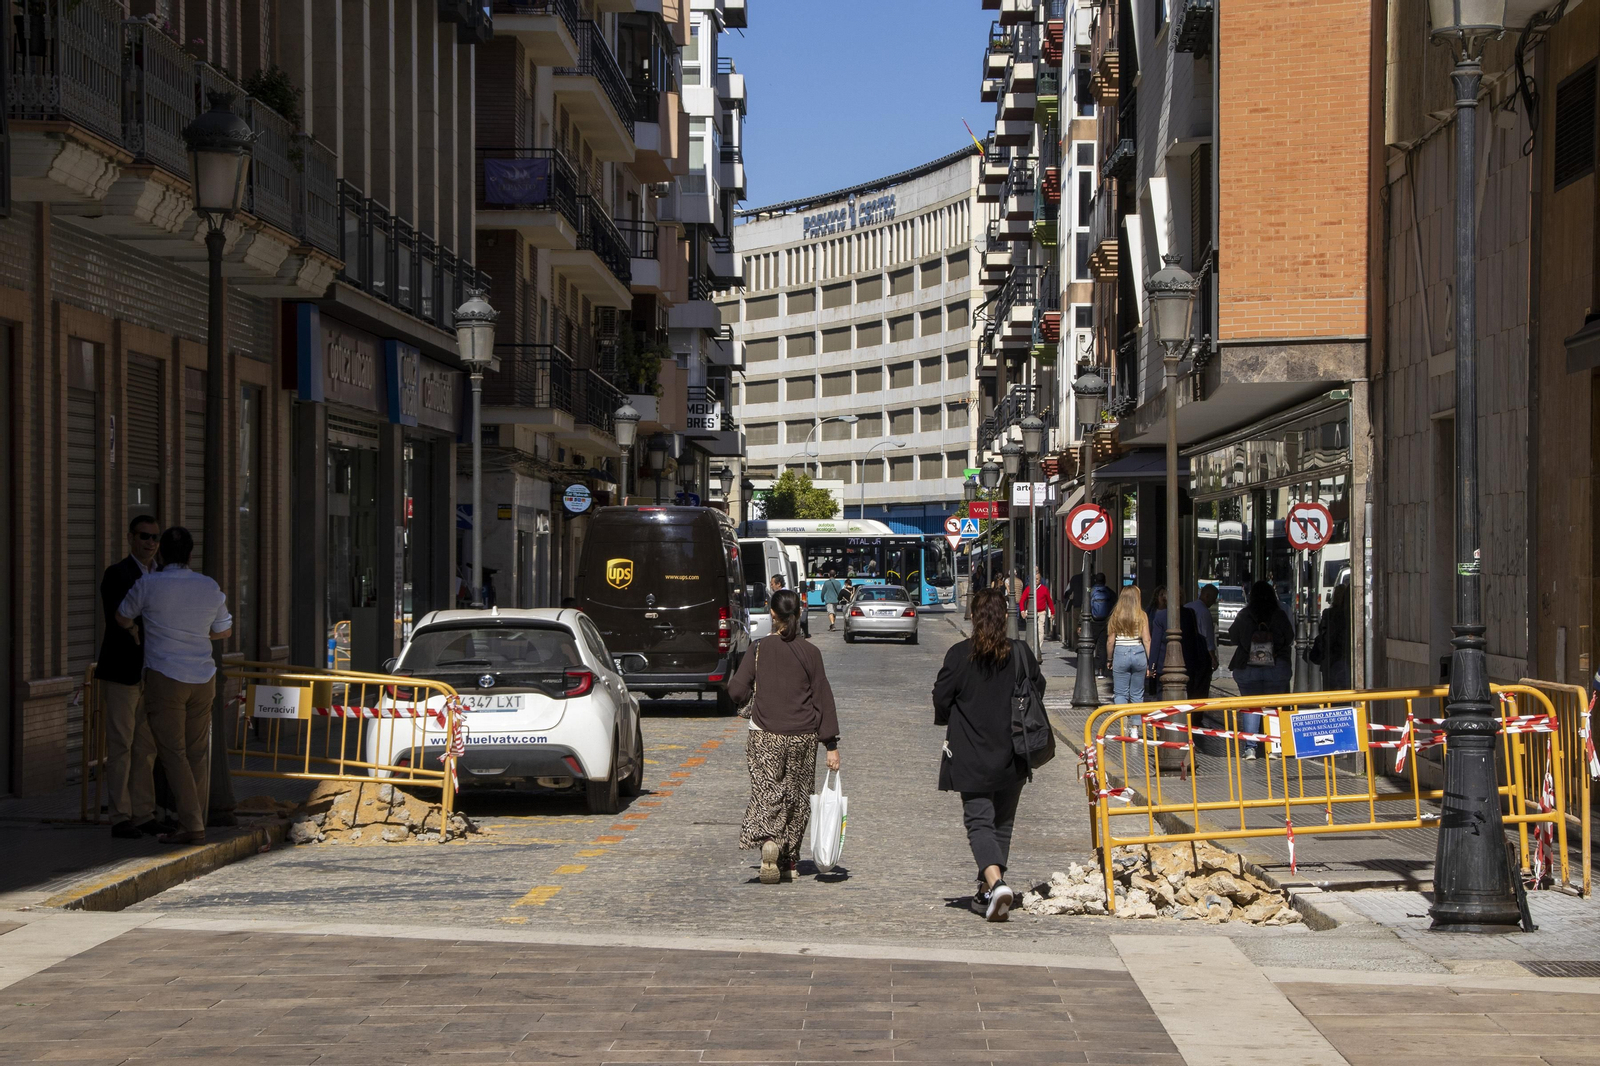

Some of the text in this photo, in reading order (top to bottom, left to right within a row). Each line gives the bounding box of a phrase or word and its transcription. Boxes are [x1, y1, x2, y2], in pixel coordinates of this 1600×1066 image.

[687, 404, 715, 415] MBU
[687, 417, 715, 428] BRES
[608, 567, 631, 584] ups
[496, 695, 522, 708] LXT
[258, 704, 295, 714] Terracivil
[1325, 710, 1352, 718] APARCAR
[1317, 722, 1350, 730] SEÑALIZADA
[430, 734, 548, 746] ww.huelvatv.com
